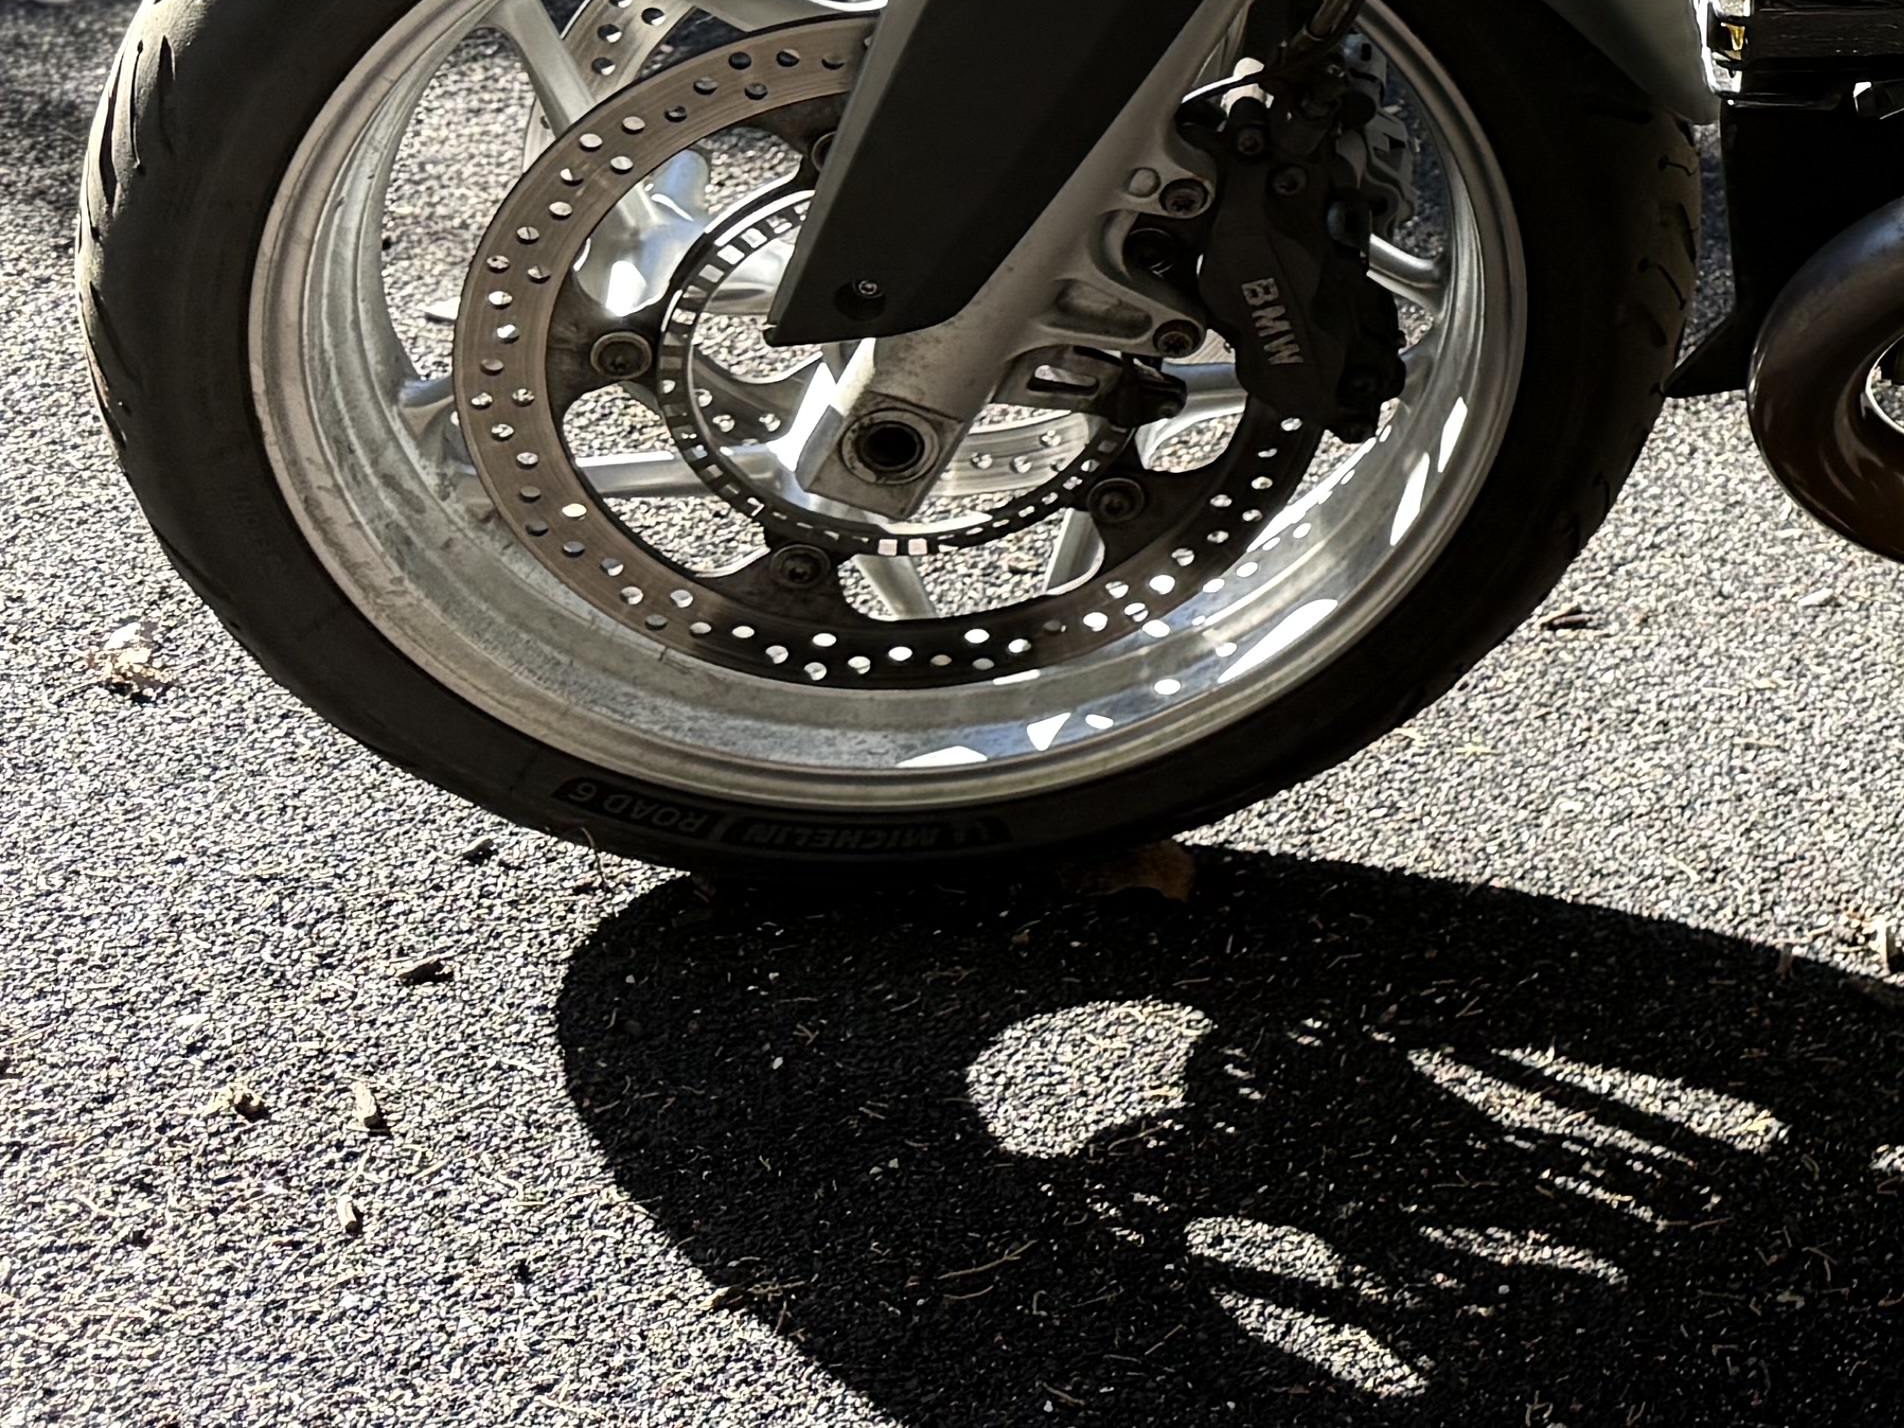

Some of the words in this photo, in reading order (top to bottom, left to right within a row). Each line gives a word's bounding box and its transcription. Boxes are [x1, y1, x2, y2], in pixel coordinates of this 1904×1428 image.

[1241, 277, 1304, 365] BMW
[568, 780, 597, 803] 6
[604, 791, 709, 834] ROAD
[744, 822, 941, 849] MICHELIN
